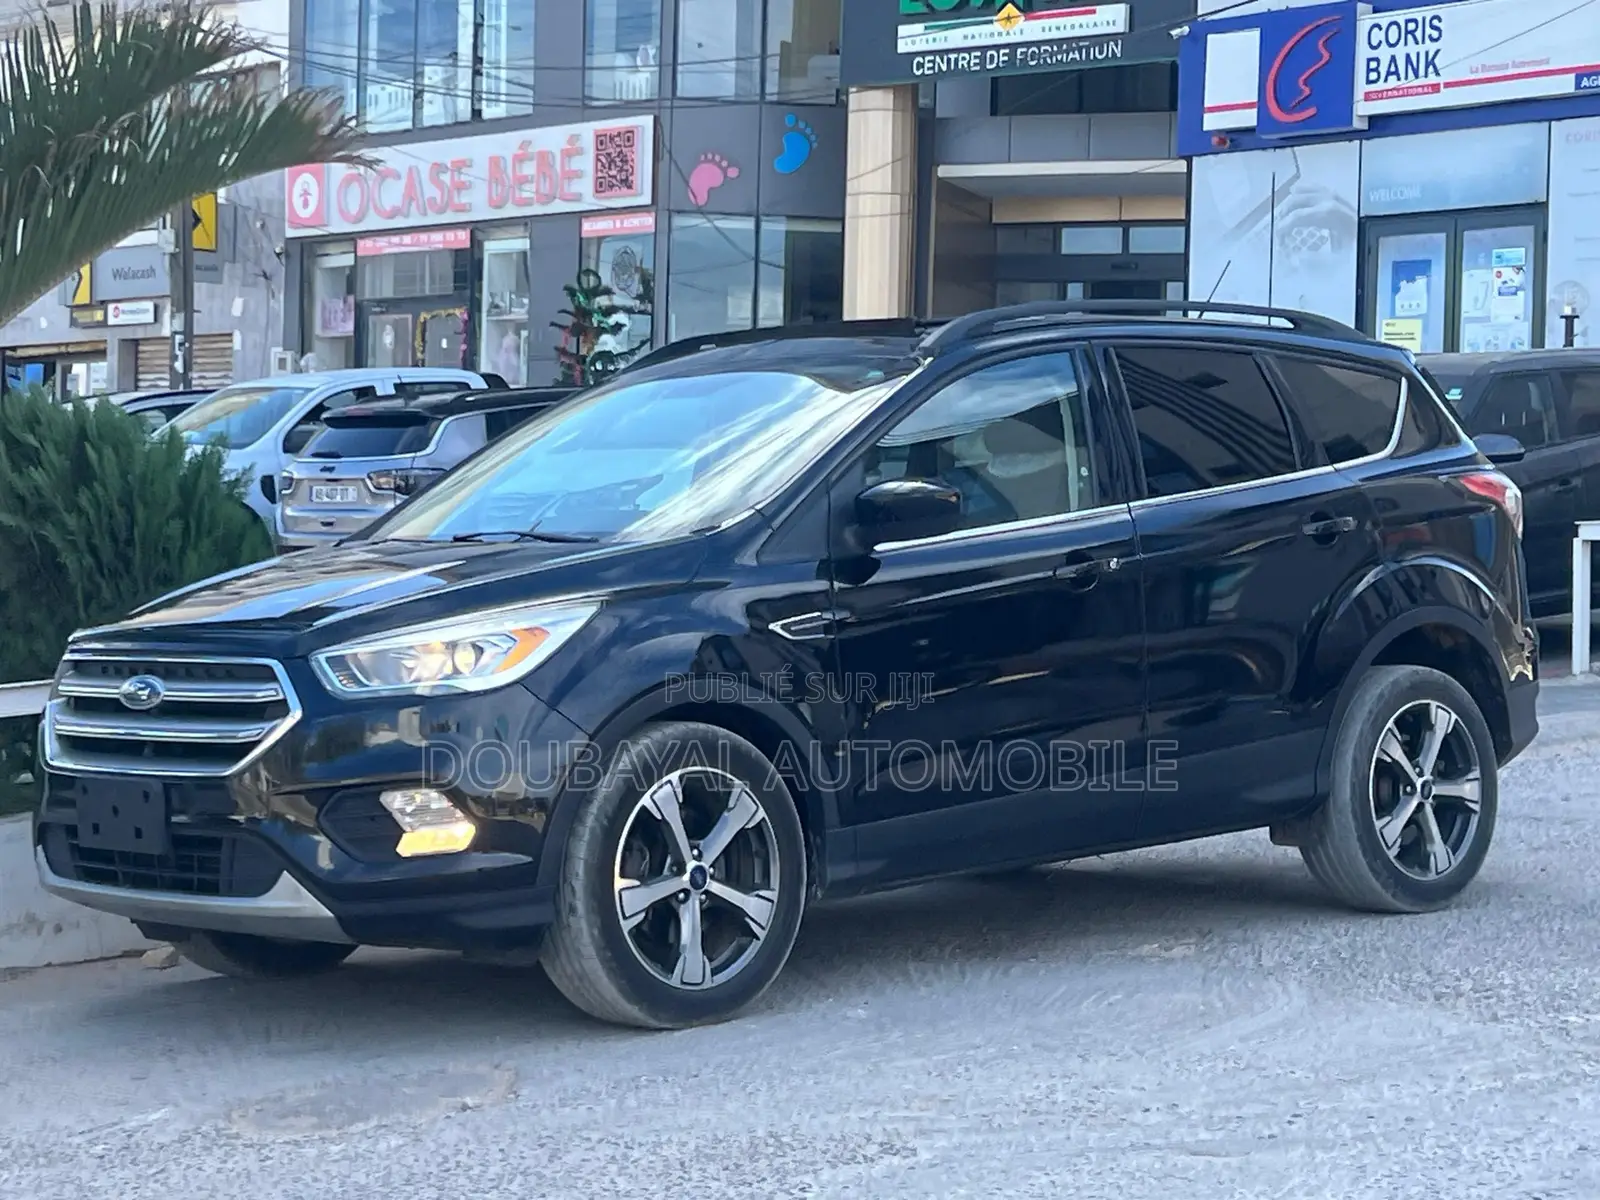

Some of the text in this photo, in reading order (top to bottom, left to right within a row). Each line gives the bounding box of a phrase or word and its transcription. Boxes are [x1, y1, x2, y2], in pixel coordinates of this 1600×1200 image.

[1367, 14, 1443, 51] CORIS
[912, 51, 981, 76] CENTRE
[986, 49, 1010, 70] DE
[1365, 48, 1442, 85] BANK
[336, 133, 584, 224] OCASE BÉBÉ
